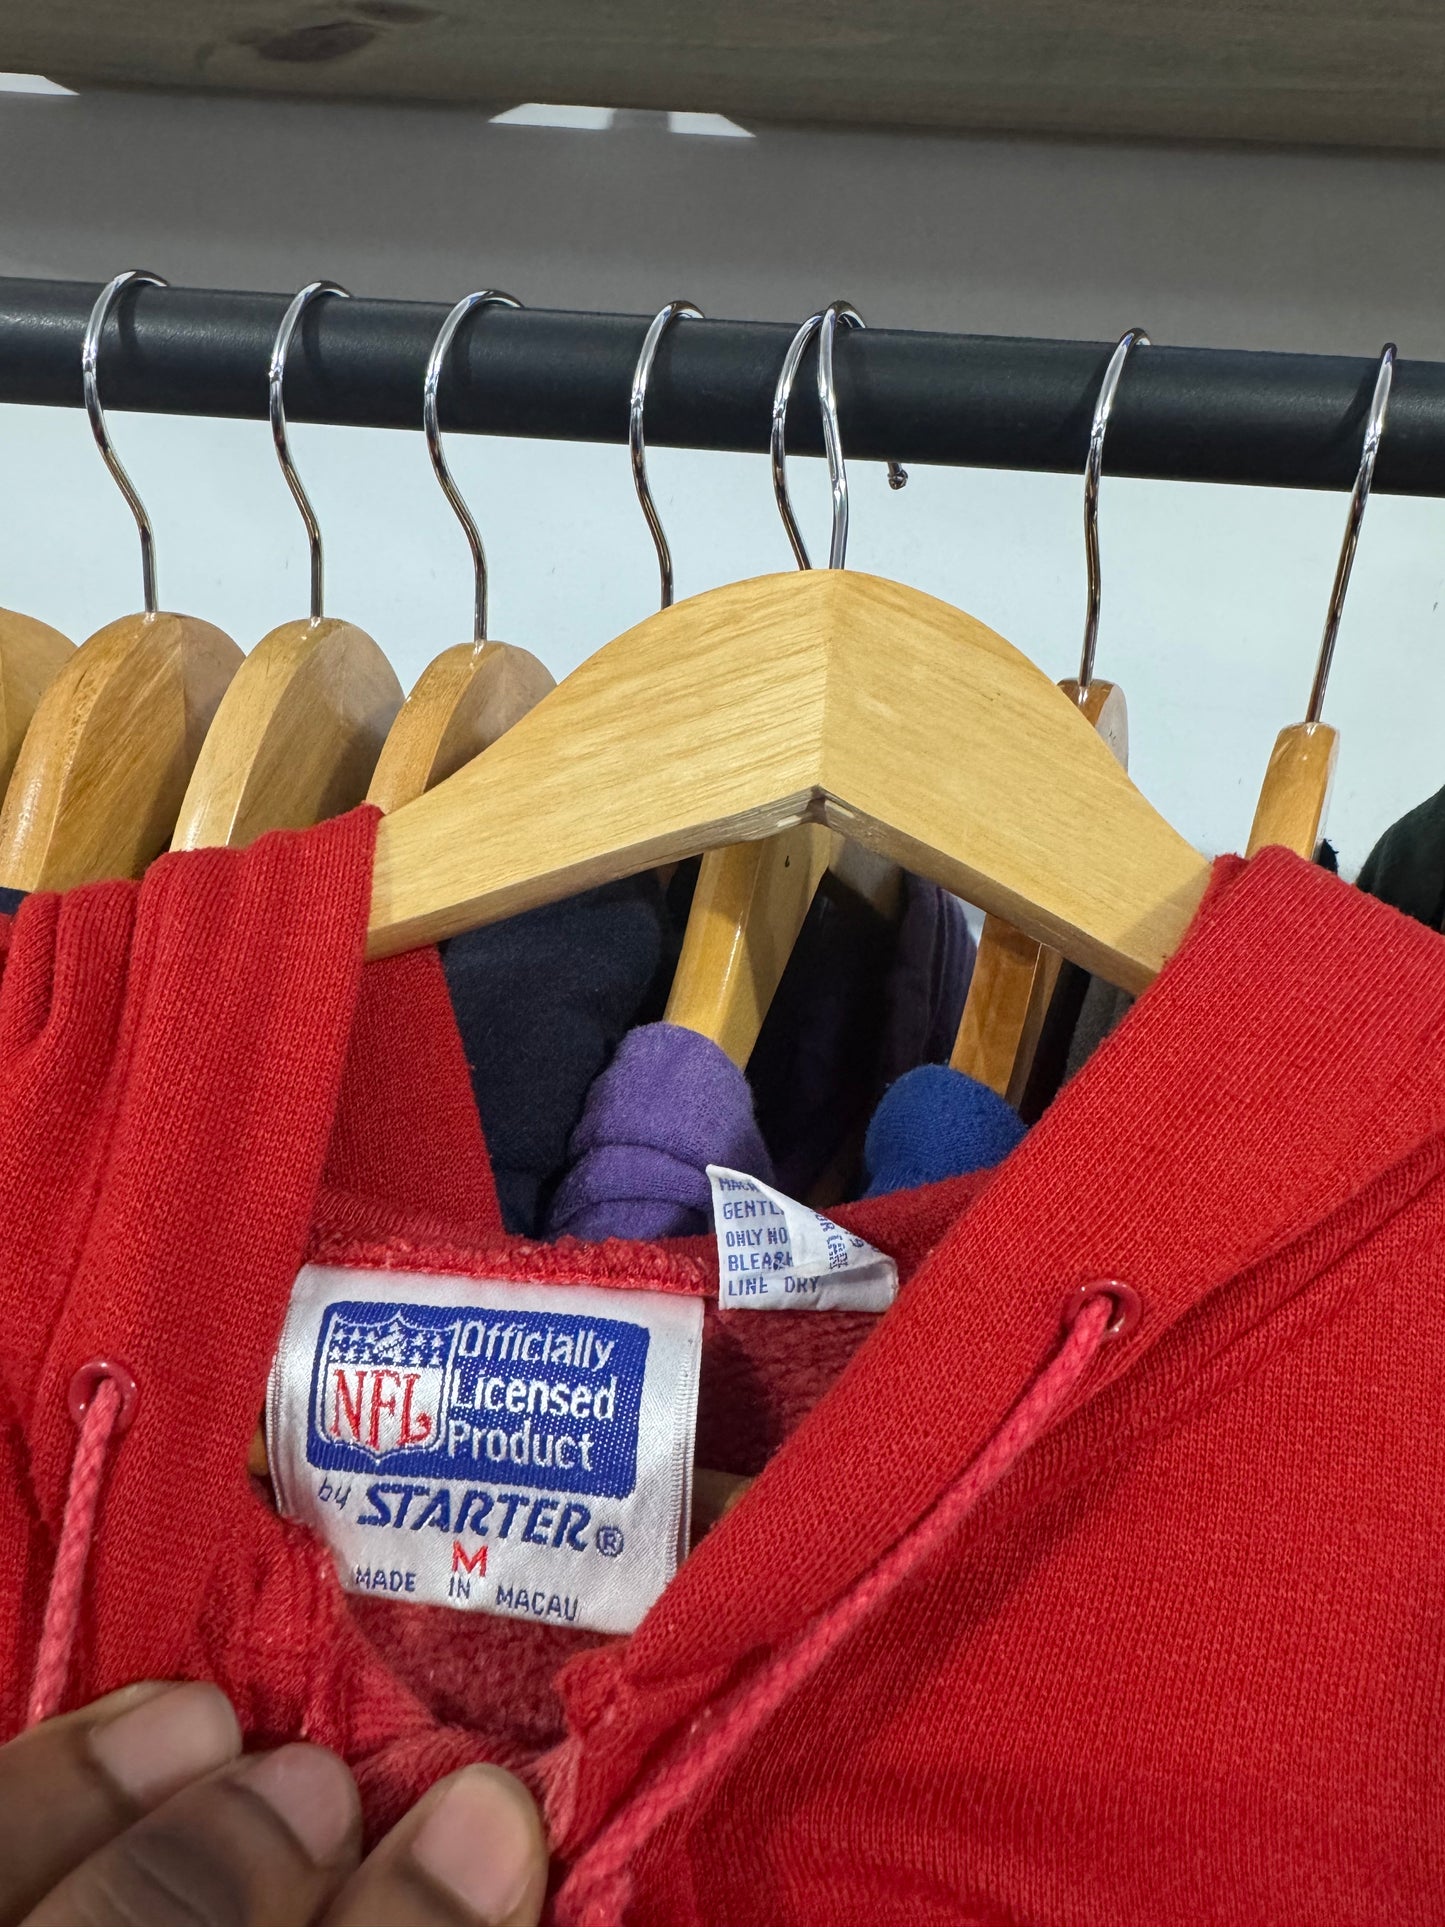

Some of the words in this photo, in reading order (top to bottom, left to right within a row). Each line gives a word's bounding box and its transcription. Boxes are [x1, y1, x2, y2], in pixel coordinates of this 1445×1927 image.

[724, 1200, 785, 1219] GENTL
[726, 1228, 763, 1248] ONLY
[728, 1276, 769, 1296] LINE
[785, 1275, 820, 1294] DRY
[457, 1319, 615, 1372] Officially
[329, 1369, 433, 1451] NFL
[451, 1374, 615, 1420] Licensed
[447, 1420, 594, 1472] Product
[318, 1477, 351, 1510] by
[452, 1541, 488, 1577] M
[355, 1567, 416, 1592] MADE
[448, 1576, 471, 1599] IN
[496, 1586, 579, 1621] MACAU
